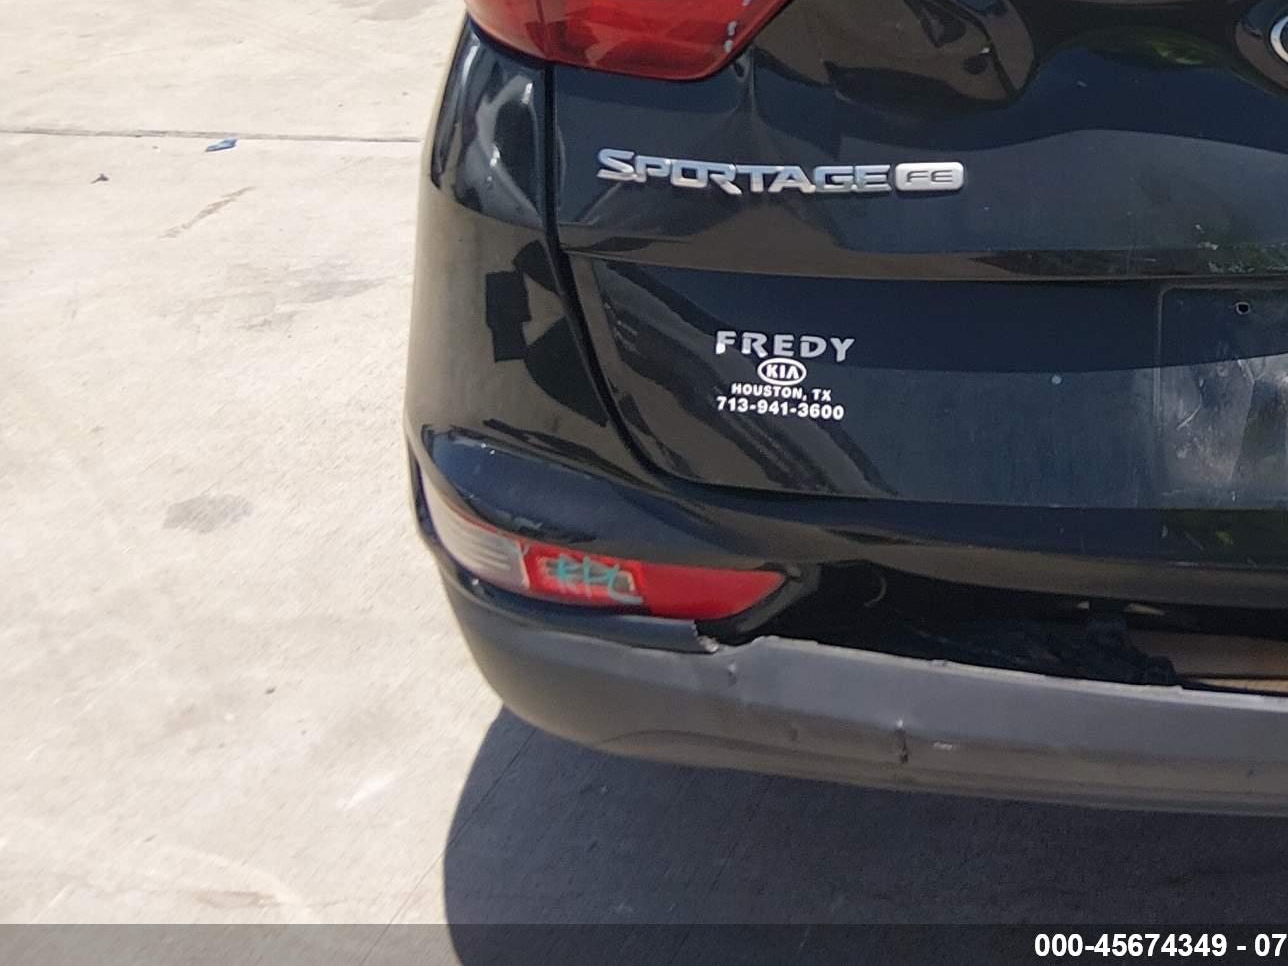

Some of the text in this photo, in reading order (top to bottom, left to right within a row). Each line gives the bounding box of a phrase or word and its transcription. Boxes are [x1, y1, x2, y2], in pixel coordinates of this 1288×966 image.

[597, 148, 955, 195] SPORTAGE FE
[715, 330, 855, 362] FREDY
[766, 363, 800, 380] KIA
[731, 383, 832, 402] HOUSTON, TX
[715, 396, 845, 421] 713-941-3600
